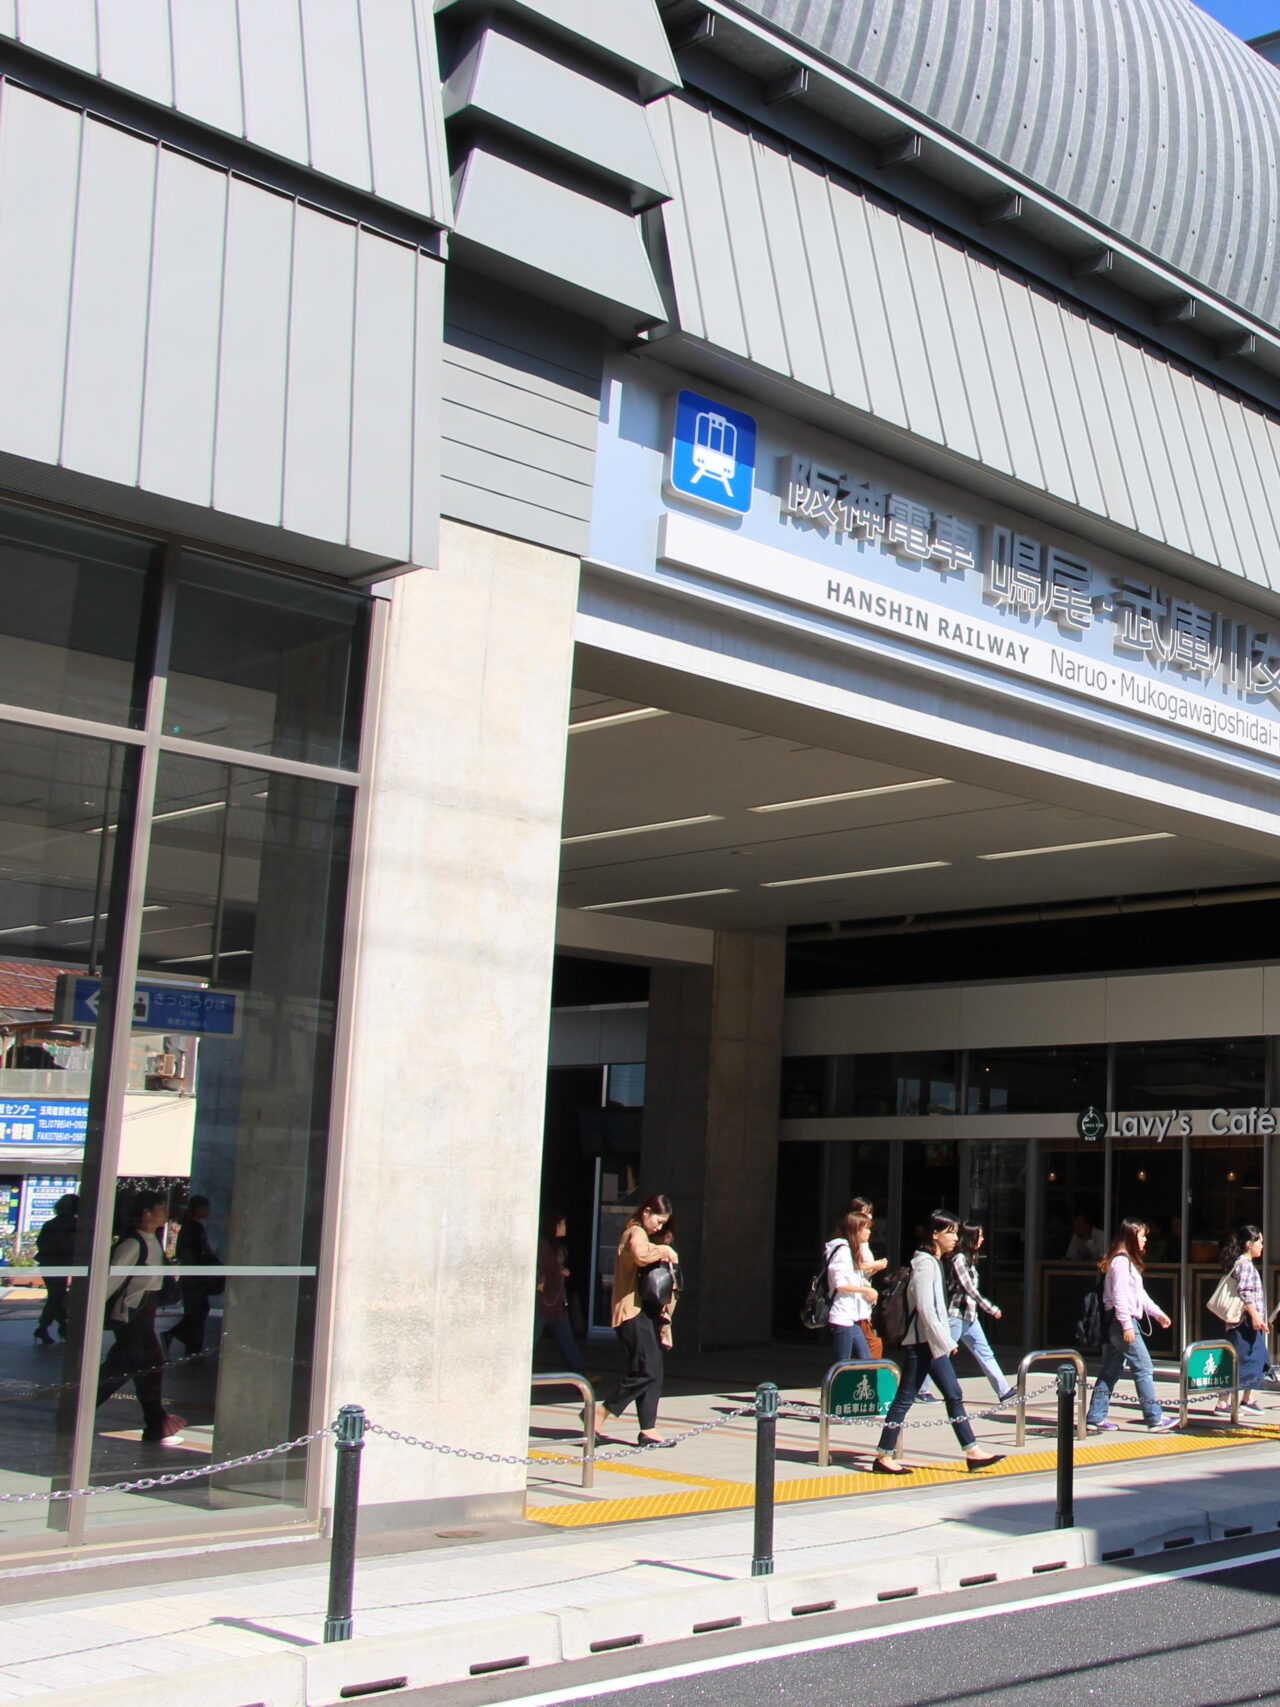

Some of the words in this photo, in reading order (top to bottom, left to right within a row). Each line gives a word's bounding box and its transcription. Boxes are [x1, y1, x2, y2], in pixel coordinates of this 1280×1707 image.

[786, 456, 975, 570] 阪神電車
[826, 579, 930, 632] HANSHIN
[938, 616, 1030, 665] RAILWAY
[1110, 1109, 1193, 1143] Lavy's
[1208, 1106, 1278, 1136] Café
[835, 1401, 892, 1415] 自転車はおして
